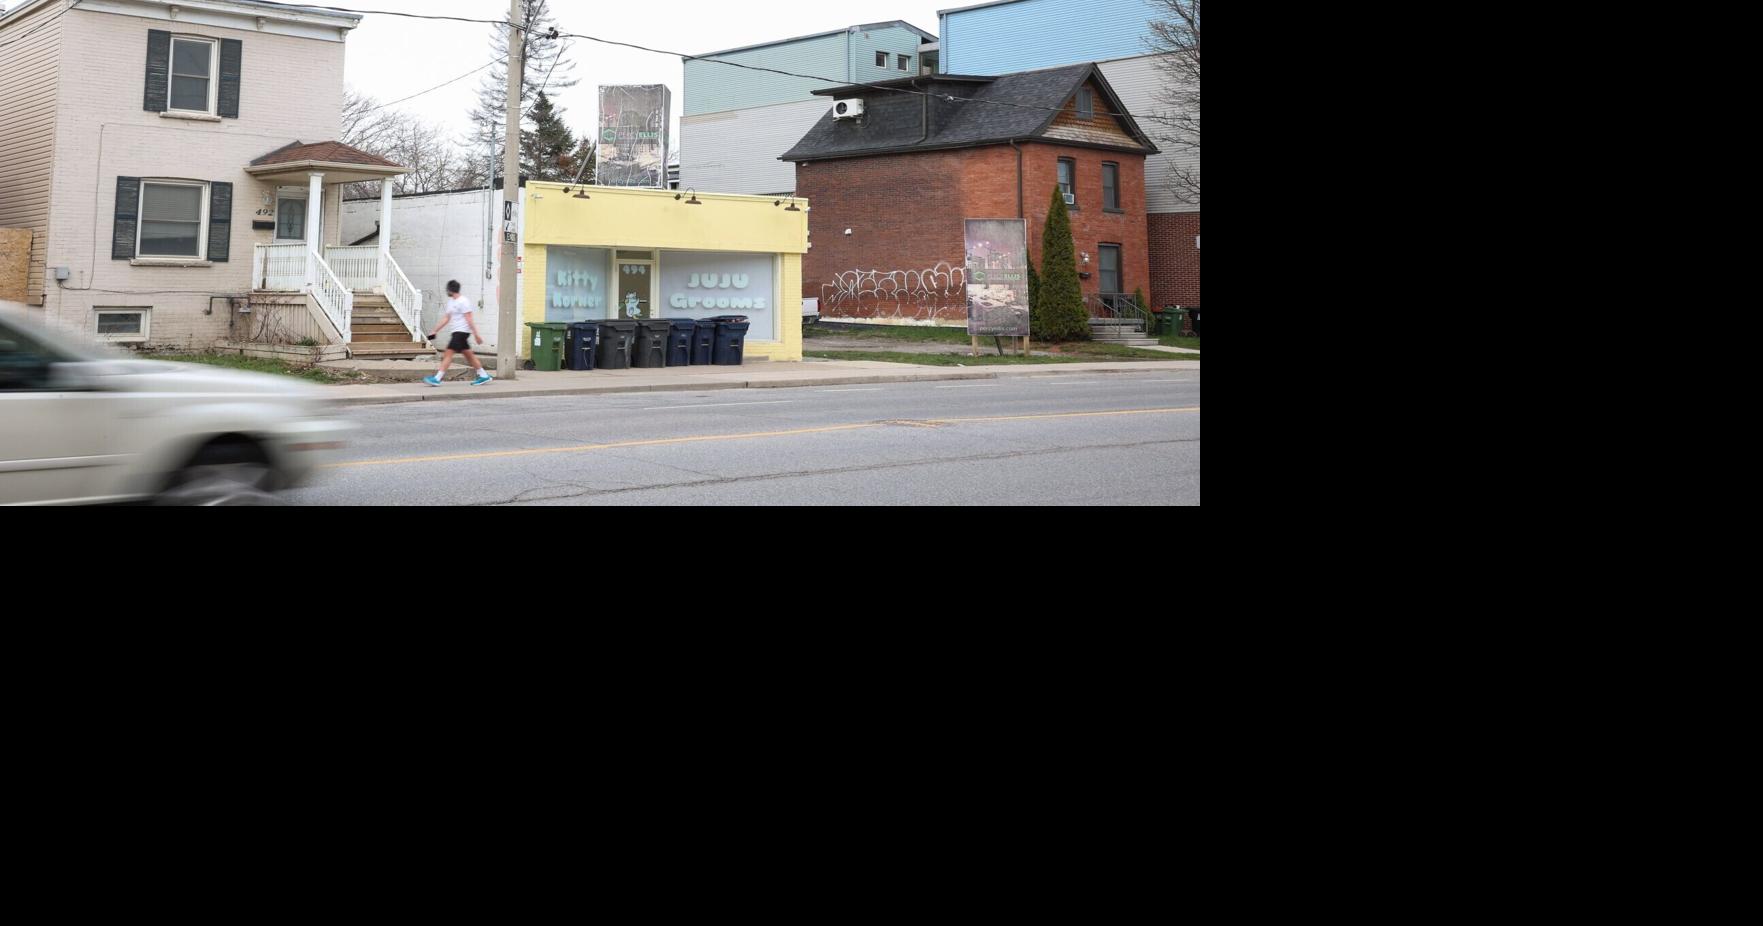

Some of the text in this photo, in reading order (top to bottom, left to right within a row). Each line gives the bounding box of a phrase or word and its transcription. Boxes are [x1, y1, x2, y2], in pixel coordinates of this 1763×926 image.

[256, 208, 274, 216] 492
[623, 265, 646, 275] 494
[557, 270, 598, 291] Kitty
[687, 272, 750, 289] JUJU
[552, 290, 602, 308] Korner
[669, 292, 767, 309] Grooms
